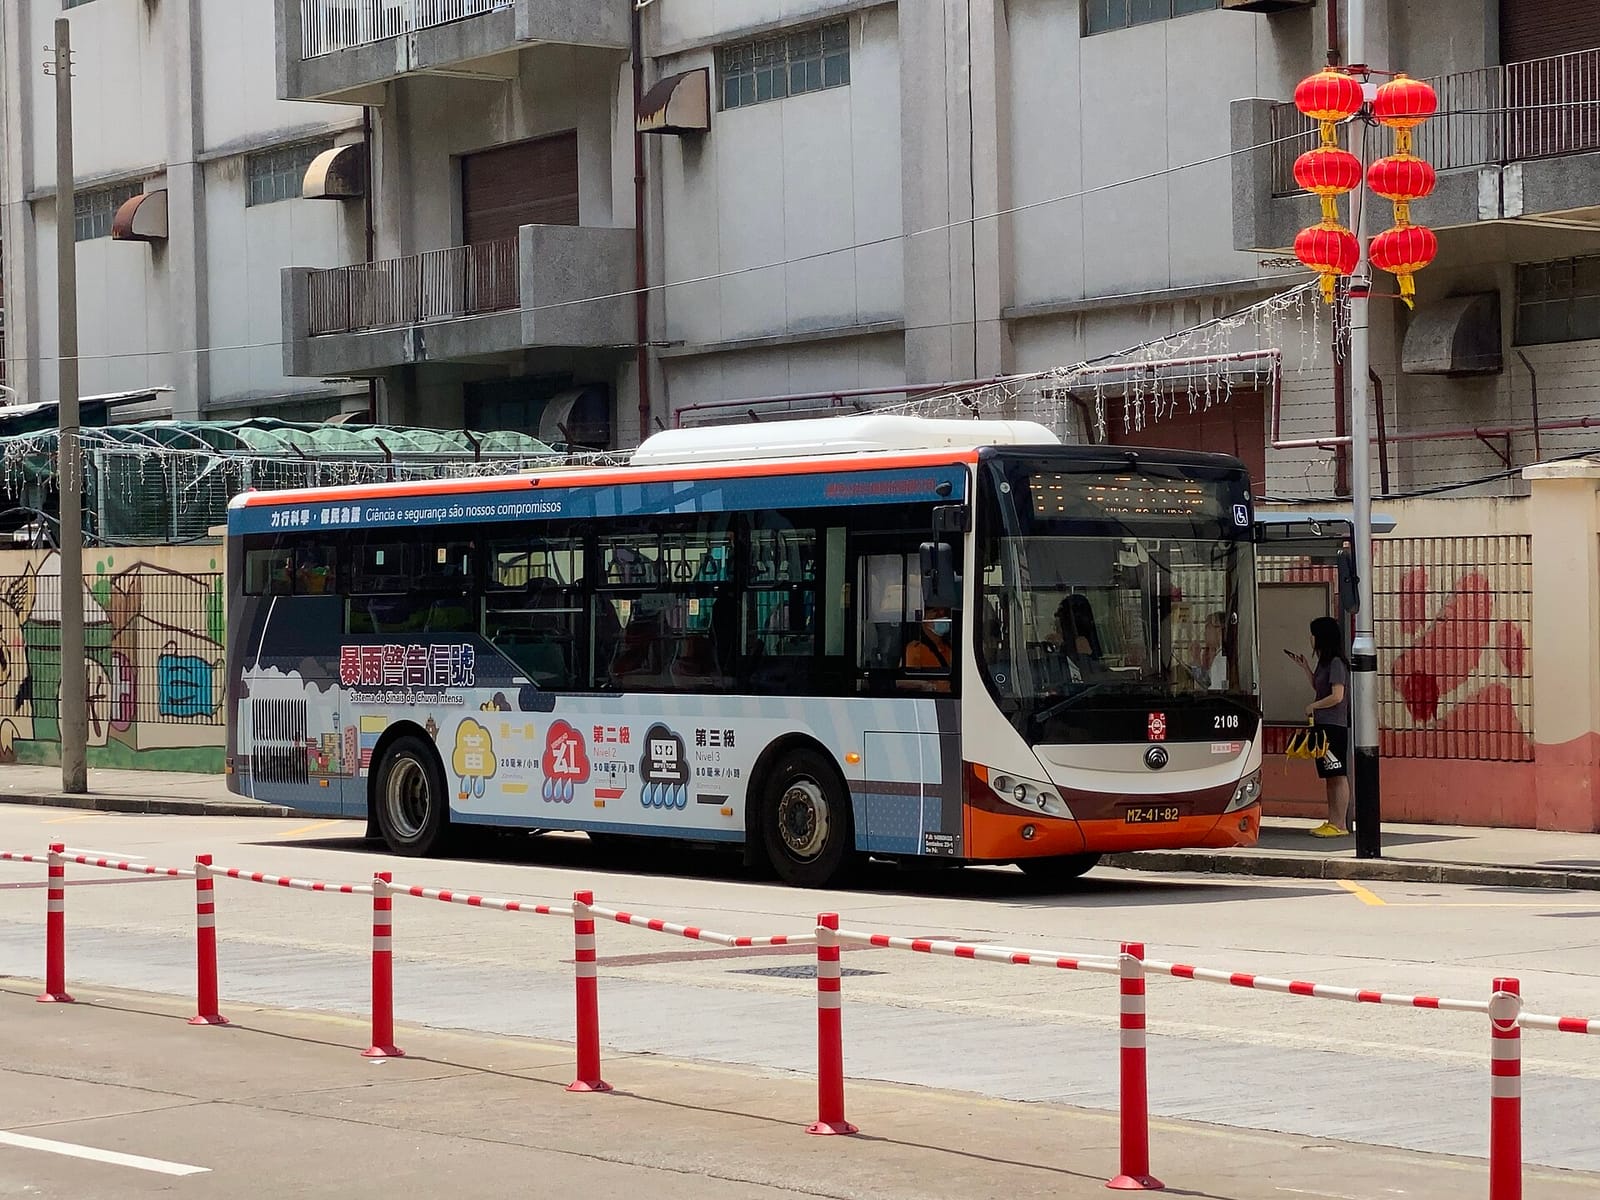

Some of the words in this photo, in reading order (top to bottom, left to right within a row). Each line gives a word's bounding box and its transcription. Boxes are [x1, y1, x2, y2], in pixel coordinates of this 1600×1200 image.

[365, 507, 395, 521] Ciência
[397, 511, 403, 520] e
[404, 507, 447, 523] segurança
[448, 504, 464, 517] são
[465, 505, 496, 517] nossos
[497, 499, 562, 517] compromissos
[340, 643, 475, 687] 暴雨警告信號
[350, 691, 375, 703] Sistema
[376, 691, 385, 703] de
[385, 691, 405, 703] Sinais
[406, 691, 416, 704] de
[416, 691, 438, 704] Chuva
[438, 692, 464, 704] Intensa
[1214, 715, 1239, 728] 2108
[695, 728, 735, 748] 第三級
[612, 747, 617, 758] 2
[715, 751, 721, 761] 3
[1127, 808, 1179, 821] MZ-41-82
